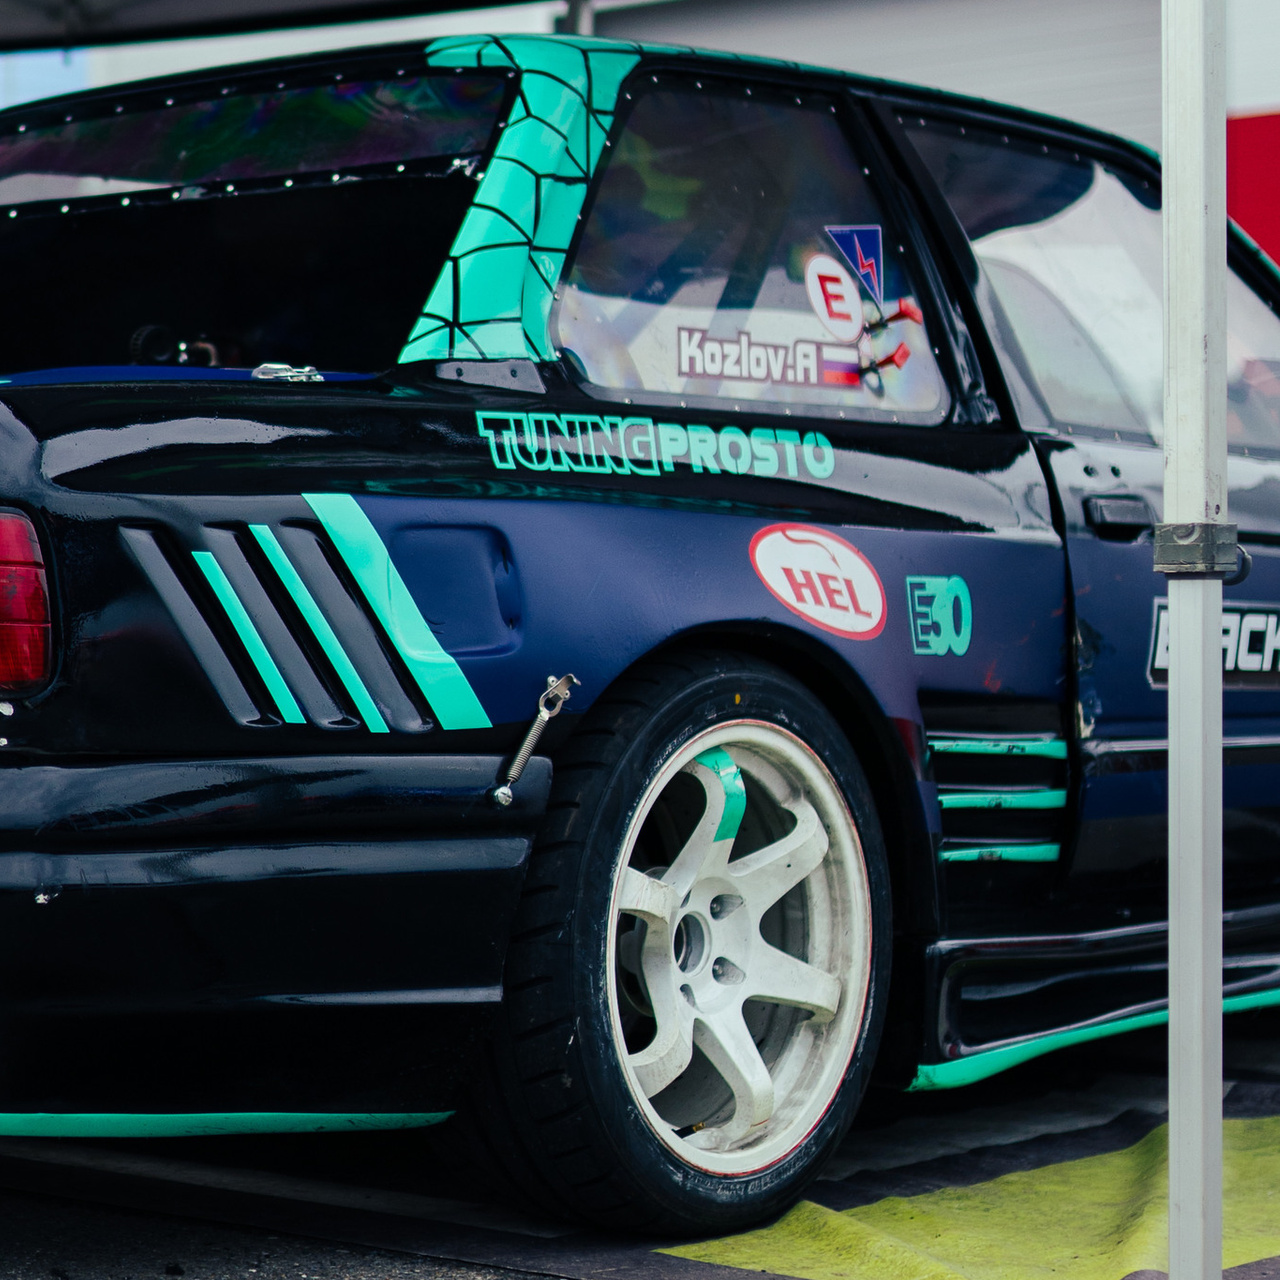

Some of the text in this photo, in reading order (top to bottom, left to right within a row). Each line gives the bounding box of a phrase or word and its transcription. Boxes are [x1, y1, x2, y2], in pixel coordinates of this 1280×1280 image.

[817, 274, 853, 323] E
[781, 567, 873, 620] HEL
[1154, 610, 1280, 672] ACK
